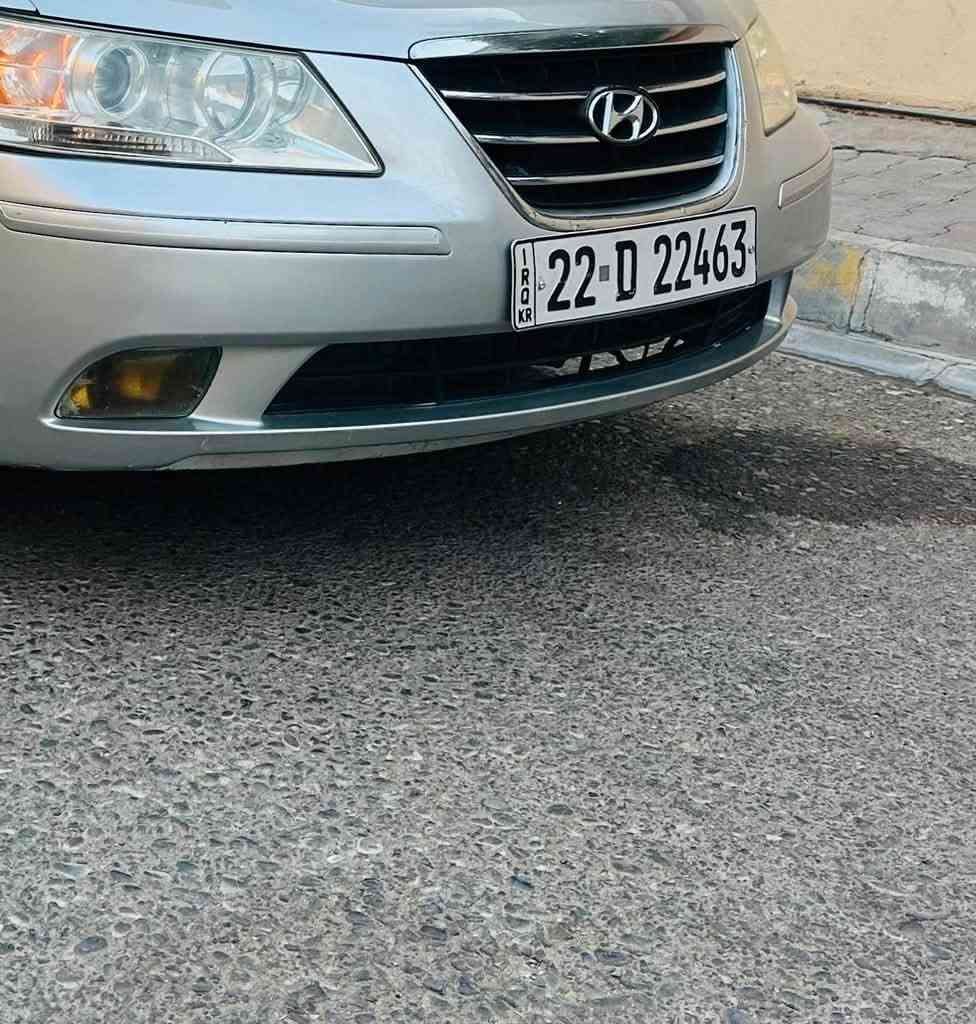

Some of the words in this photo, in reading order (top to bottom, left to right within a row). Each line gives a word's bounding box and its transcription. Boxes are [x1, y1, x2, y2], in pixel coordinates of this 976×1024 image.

[547, 245, 596, 312] 22
[615, 239, 638, 302] D
[653, 220, 747, 296] 22463
[518, 307, 532, 323] KR
